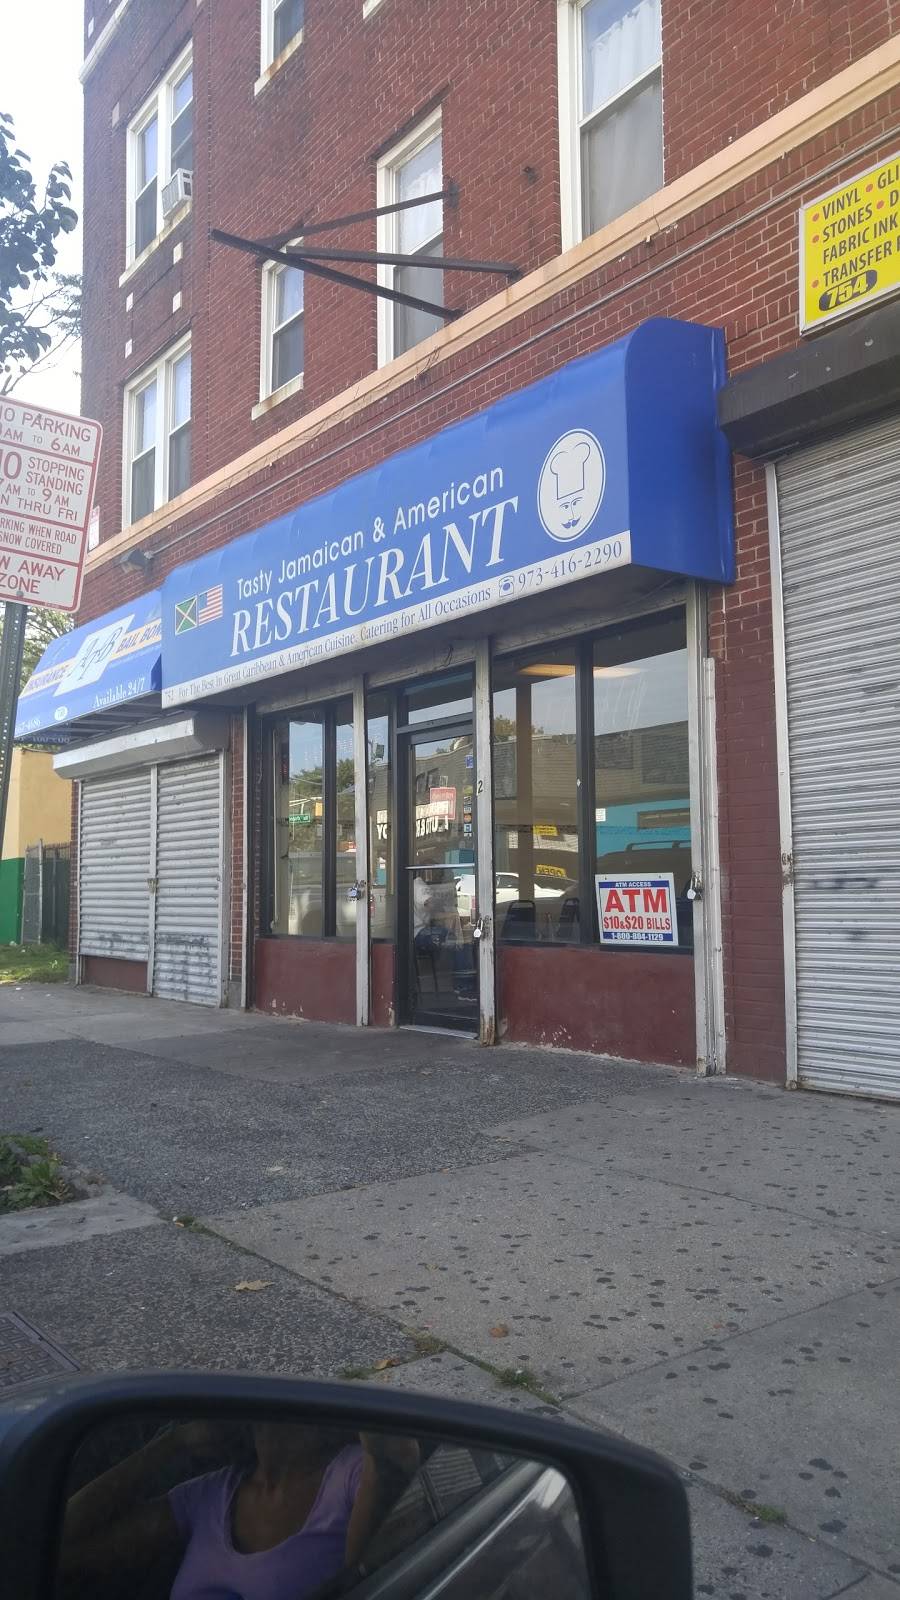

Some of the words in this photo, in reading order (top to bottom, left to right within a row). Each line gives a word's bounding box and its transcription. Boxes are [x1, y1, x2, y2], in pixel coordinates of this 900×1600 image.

[822, 187, 861, 220] VINYL
[822, 202, 873, 243] STONES
[823, 226, 870, 265] FABRIC
[873, 212, 898, 239] INK
[823, 240, 893, 287] TRANSFER
[826, 272, 869, 308] 754
[22, 411, 91, 442] PARKING
[33, 435, 43, 444] TO
[28, 456, 85, 481] STOPPING
[25, 471, 83, 496] STANDING
[28, 487, 36, 496] TO
[17, 497, 52, 515] THRU
[58, 507, 78, 521] FRI
[25, 537, 62, 555] COVERED
[29, 524, 52, 539] WHEN
[54, 530, 77, 545] ROAD
[237, 569, 272, 600] Tasty
[278, 530, 364, 583] Jamaican
[372, 516, 386, 543] &
[393, 467, 504, 535] American
[18, 560, 66, 581] AWAY
[230, 496, 519, 657] RESTAURANT
[0, 573, 41, 594] ZONE
[179, 686, 188, 698] For
[223, 669, 241, 684] Great
[242, 657, 277, 679] Caribbean
[278, 654, 287, 667] &
[287, 644, 323, 665] American
[360, 617, 399, 641] Catering
[400, 610, 416, 628] for
[418, 603, 431, 622] All
[435, 586, 492, 617] Occasions
[518, 540, 622, 592] 973-416-2290
[604, 888, 668, 913] ATM
[646, 917, 671, 931] BILLS
